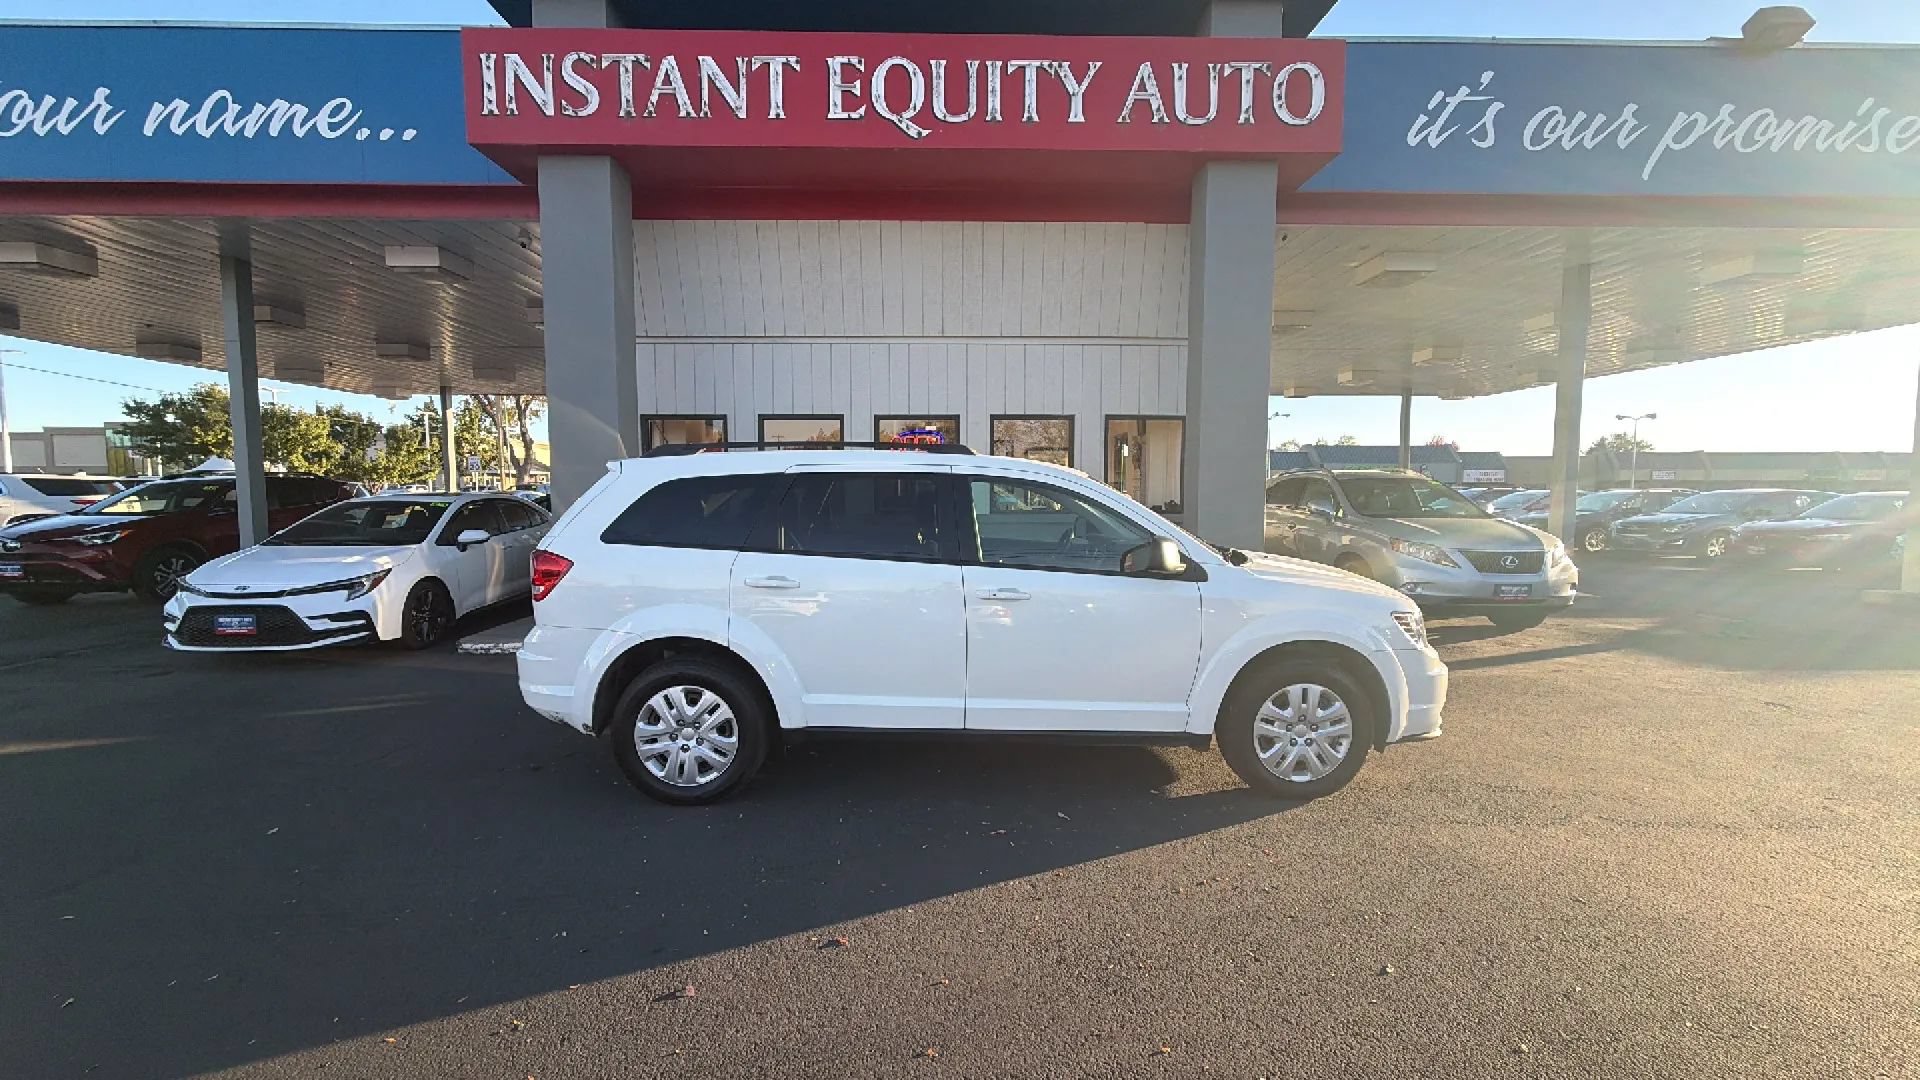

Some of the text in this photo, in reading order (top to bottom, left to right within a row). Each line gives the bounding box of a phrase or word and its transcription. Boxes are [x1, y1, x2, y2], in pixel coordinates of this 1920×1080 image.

[143, 89, 418, 141] name...
[479, 51, 1326, 139] INSTANT EQUITY AUTO
[1406, 70, 1920, 181] it's our promise
